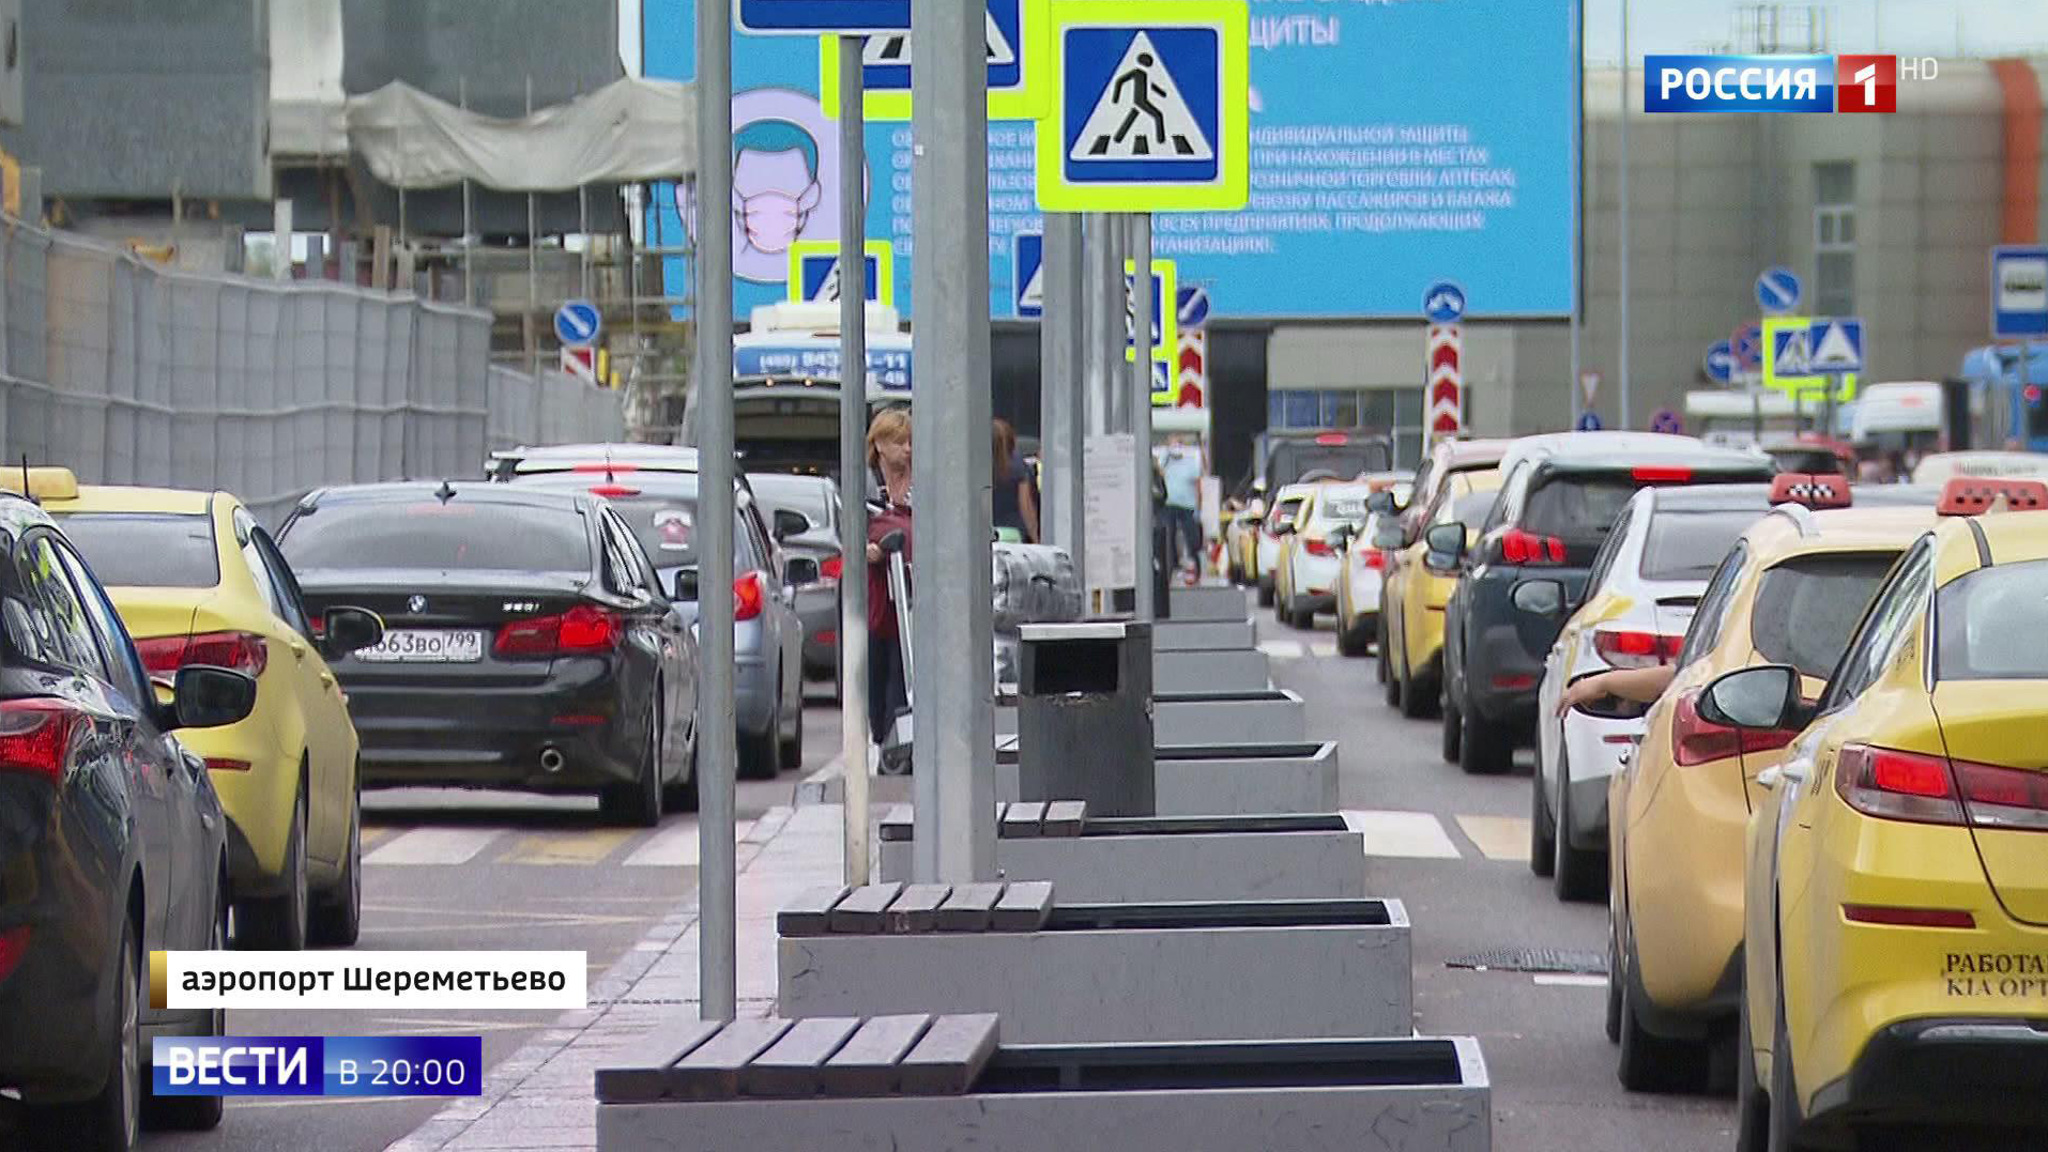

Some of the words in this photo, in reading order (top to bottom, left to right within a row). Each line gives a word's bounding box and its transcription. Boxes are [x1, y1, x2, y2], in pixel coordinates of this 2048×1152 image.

[1249, 16, 1338, 48] ЩИТЫ
[1248, 125, 1393, 145] НДИВИДУАЛЬНОЙ
[1399, 125, 1468, 145] ЗАЩИТЫ
[1423, 148, 1488, 165] МЕСТАХ
[1249, 169, 1346, 188] ОЗНИЧНОЙ
[1315, 191, 1428, 208] ПАССАЖИРОВ
[1446, 191, 1512, 208] БАГАЖА
[1335, 212, 1485, 231] ПРОДОЛЖАЮЩИХ
[366, 632, 442, 654] 663ВО
[1946, 953, 2048, 973] РАБОТА
[1947, 979, 1991, 996] KIA
[1999, 979, 2048, 997] OPT
